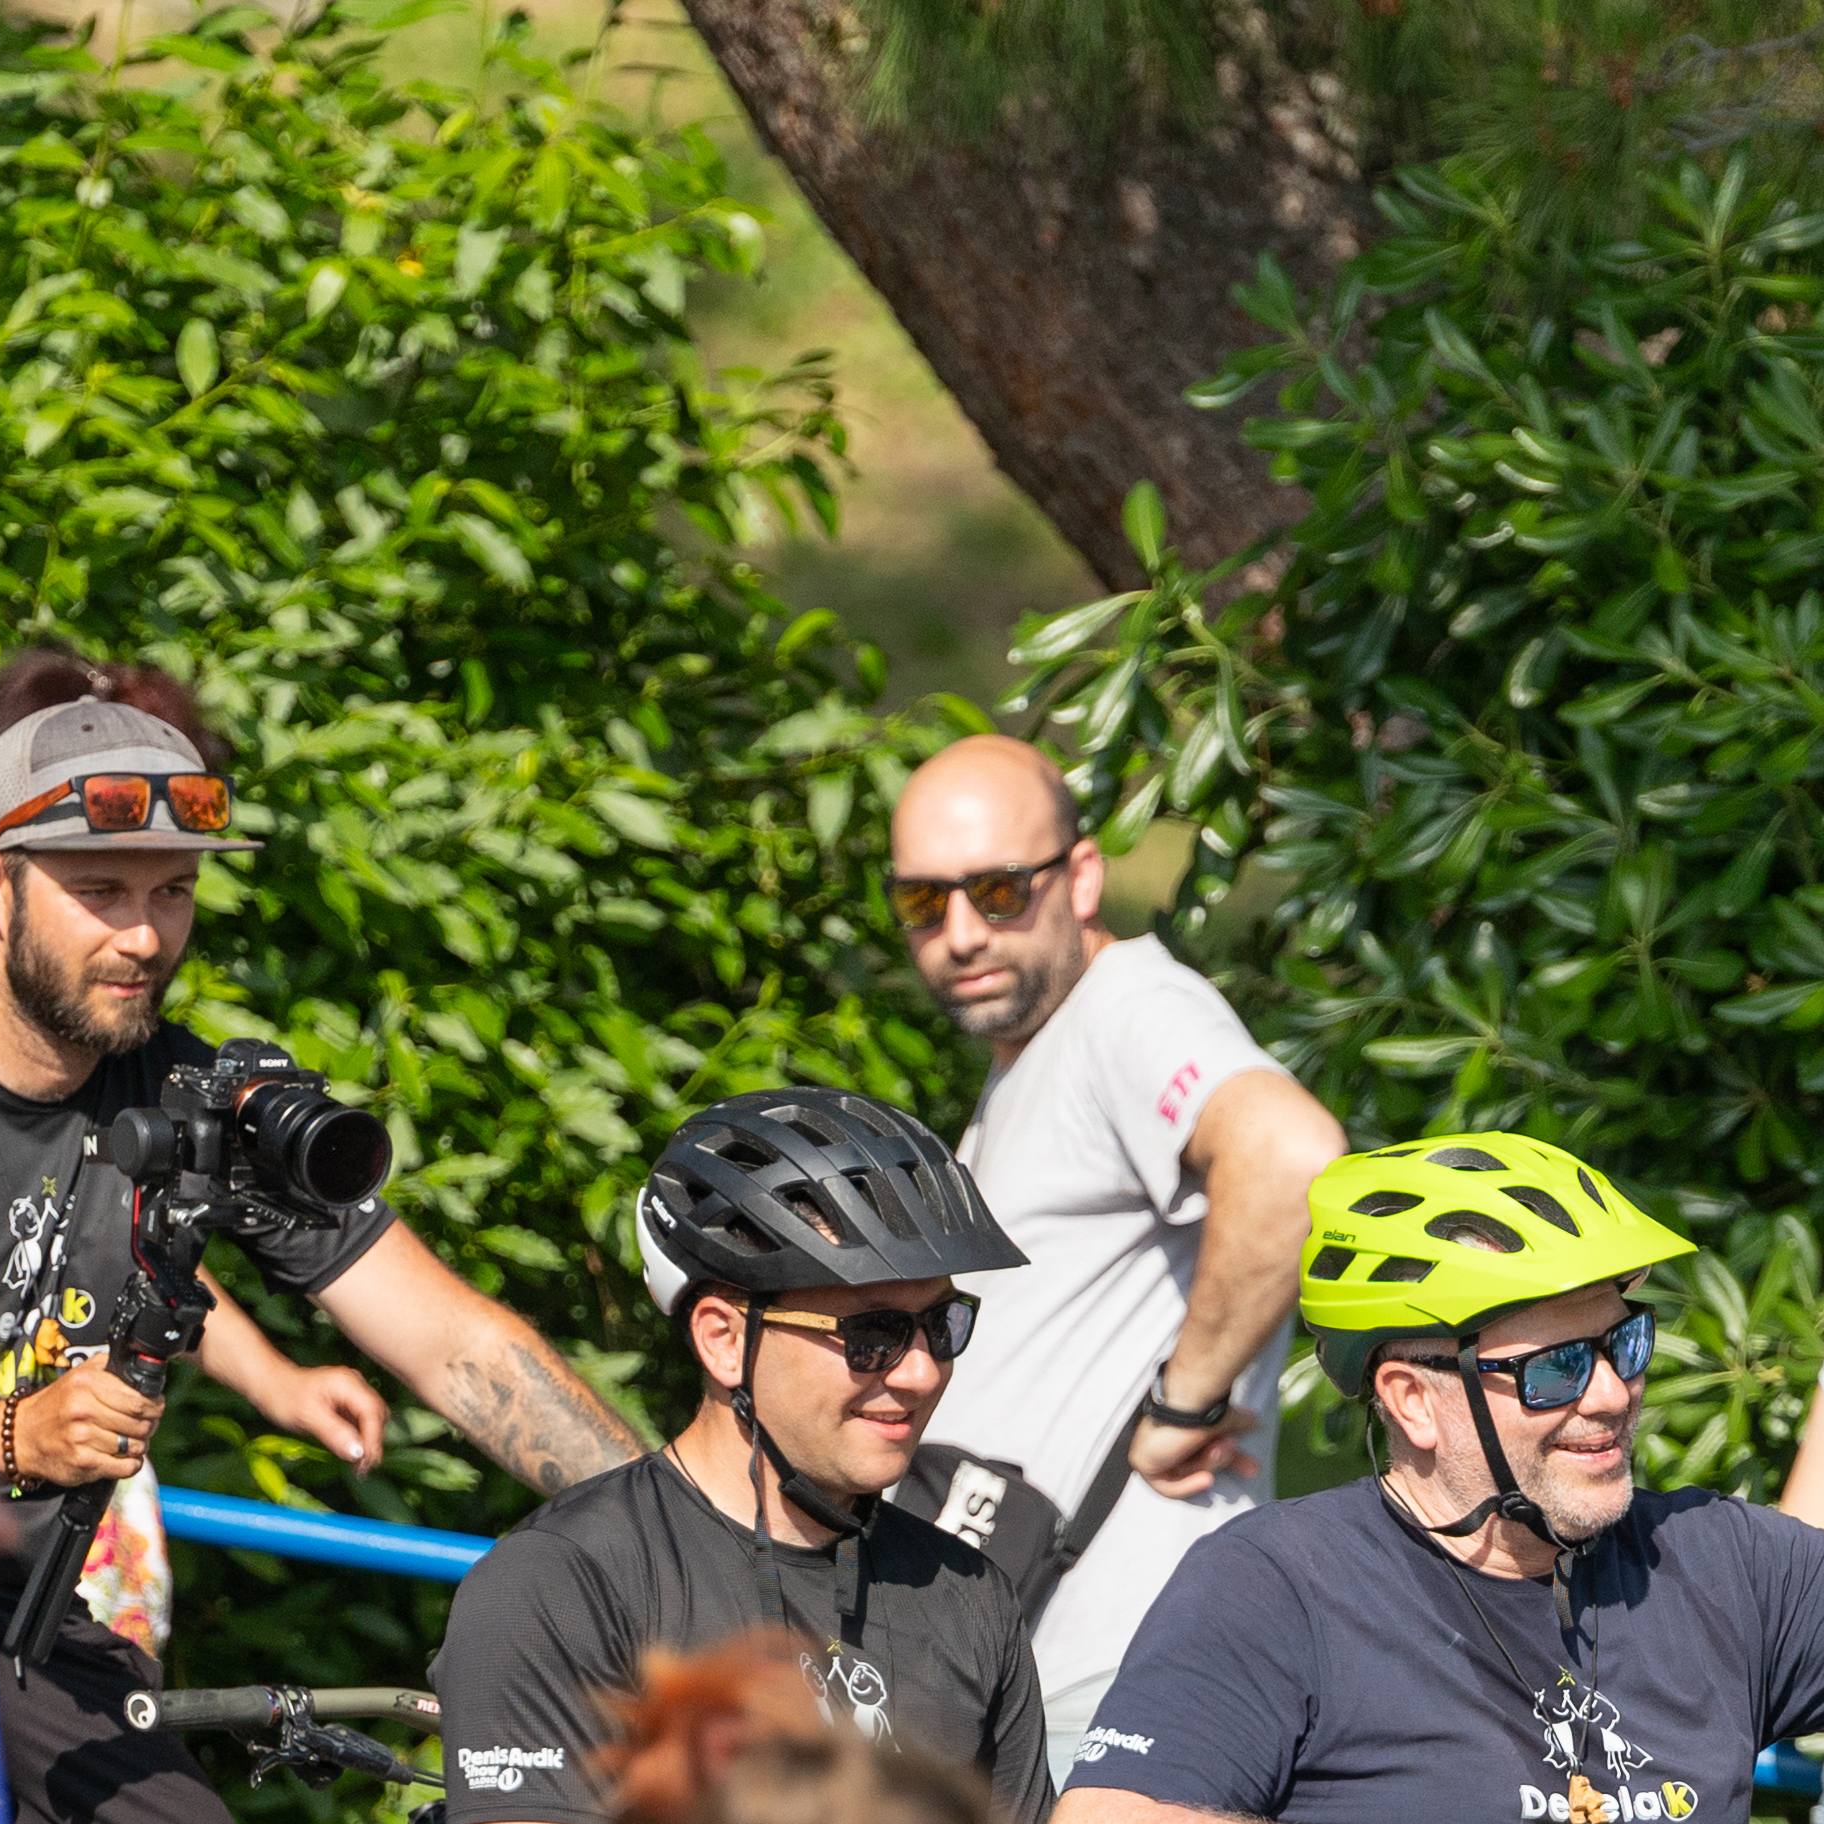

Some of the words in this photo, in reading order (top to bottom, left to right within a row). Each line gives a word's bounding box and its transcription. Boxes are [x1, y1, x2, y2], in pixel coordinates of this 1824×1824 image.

[259, 1058, 288, 1068] SONY
[651, 1195, 677, 1229] elan
[1322, 1229, 1356, 1243] elan
[465, 1764, 499, 1779] Show
[469, 1777, 497, 1786] RADIO
[1519, 1781, 1698, 1823] Deelak
